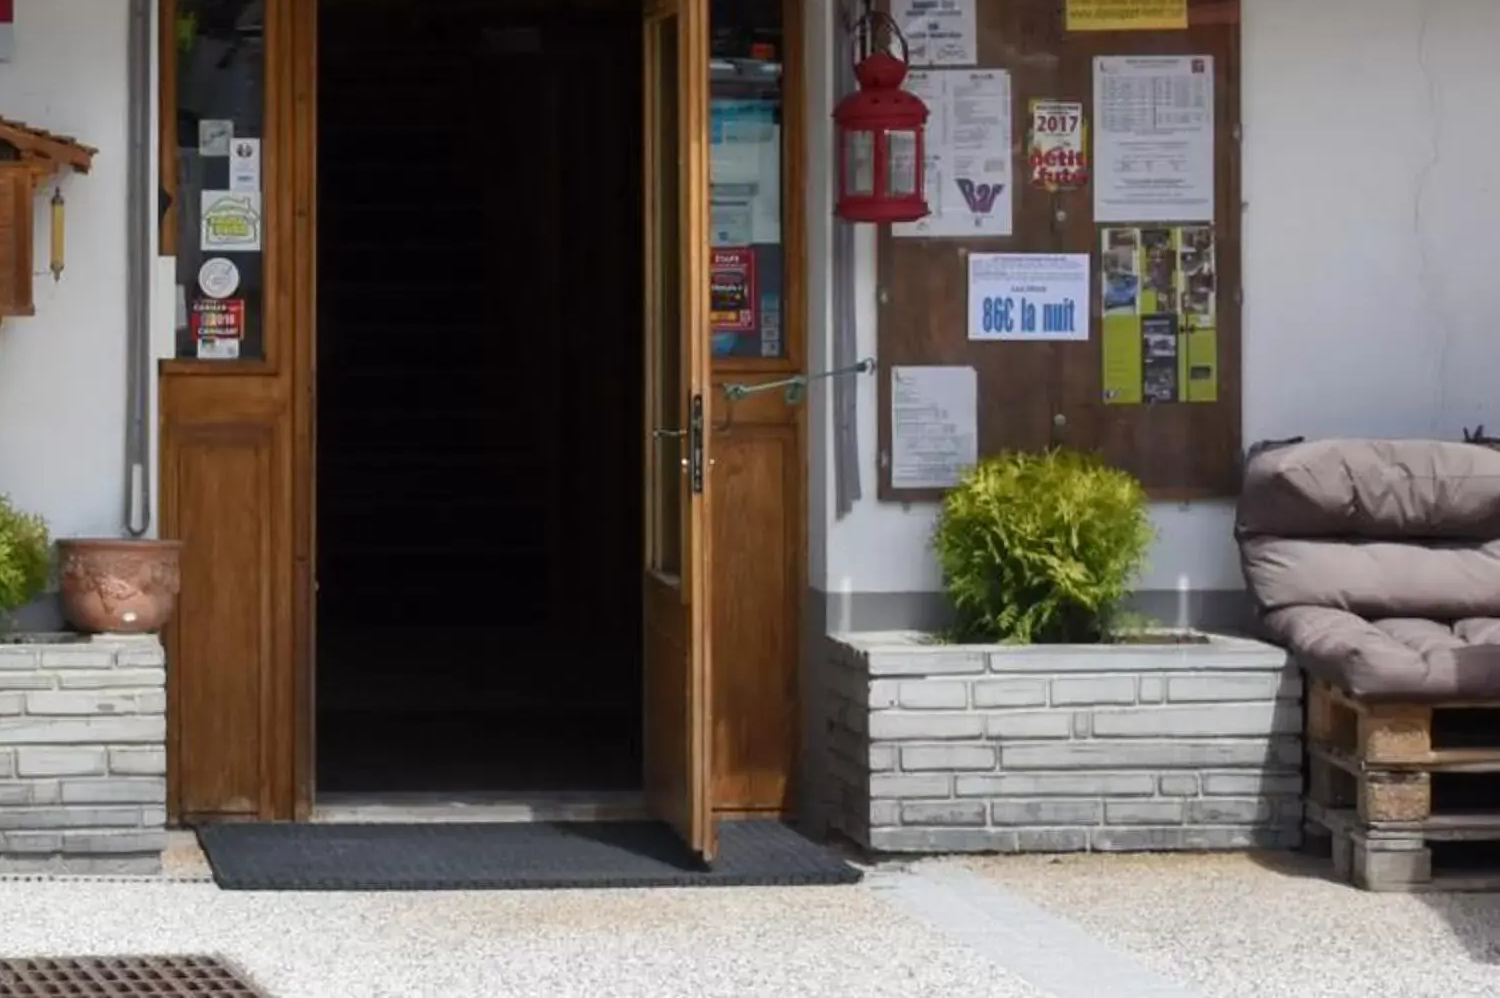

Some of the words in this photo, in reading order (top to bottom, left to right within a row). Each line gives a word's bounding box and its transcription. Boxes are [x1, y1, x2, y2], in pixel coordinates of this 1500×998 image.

[1037, 116, 1079, 133] 2017
[1021, 296, 1036, 332] la
[1043, 297, 1076, 332] nuit
